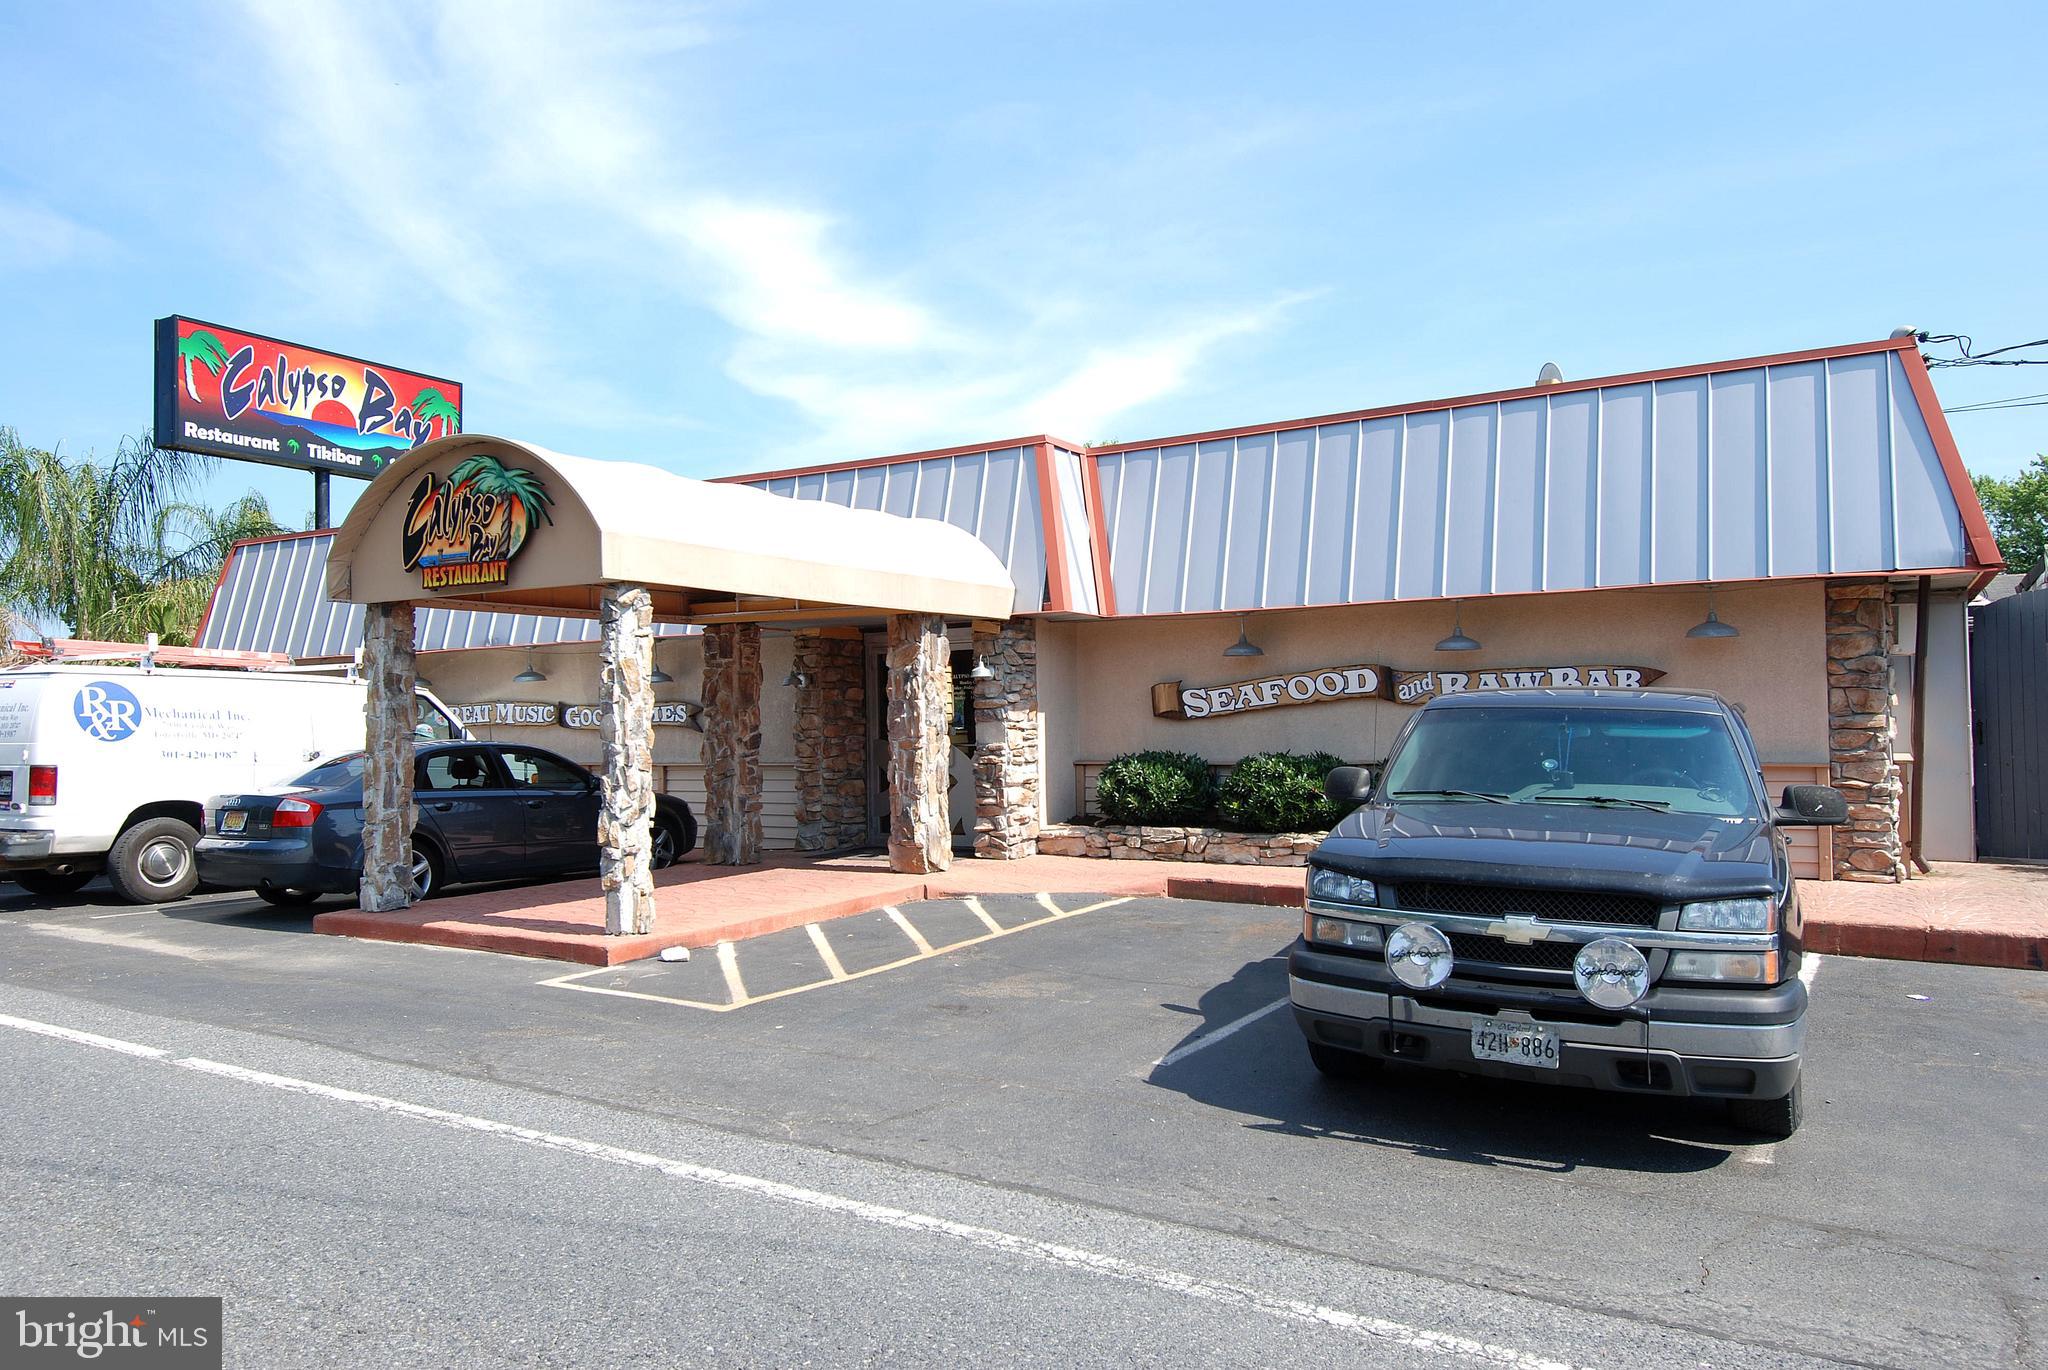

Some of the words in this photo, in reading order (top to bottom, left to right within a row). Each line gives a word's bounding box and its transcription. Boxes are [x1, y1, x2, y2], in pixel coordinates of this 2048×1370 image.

[221, 346, 347, 420] Calypso
[358, 367, 433, 450] Bay
[184, 421, 280, 452] Restaurant
[307, 443, 363, 467] Tikibar
[403, 472, 498, 573] Calypso
[422, 559, 510, 589] RESTAURANT
[1181, 668, 1379, 719] SEAFOOD
[1398, 671, 1435, 700] and
[1436, 672, 1546, 695] RAW
[1547, 667, 1643, 688] BAR
[145, 706, 221, 721] Mechanical
[496, 703, 556, 724] MUSIC
[160, 750, 239, 760] 301-420-1987
[1521, 1036, 1555, 1059] 886
